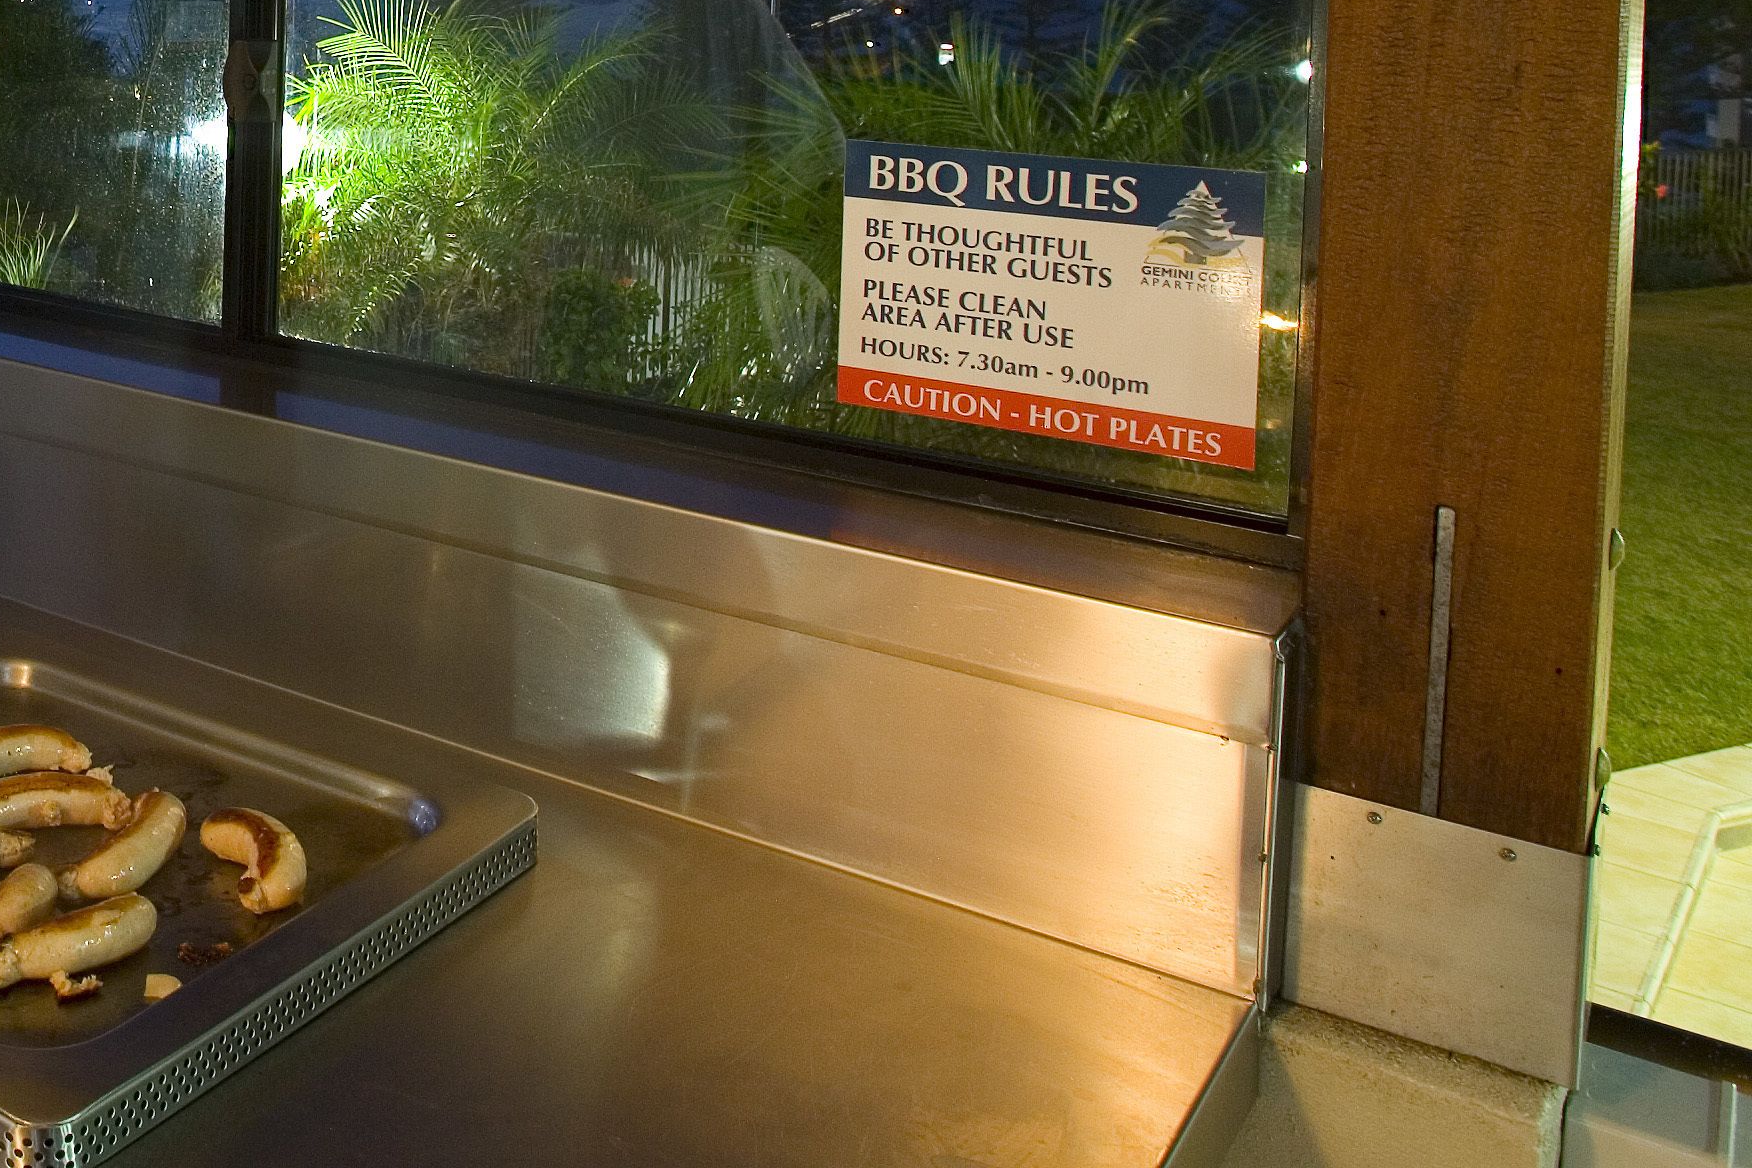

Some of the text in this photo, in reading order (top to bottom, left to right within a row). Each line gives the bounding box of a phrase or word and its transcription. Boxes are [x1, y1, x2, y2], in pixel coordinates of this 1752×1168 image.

[869, 154, 1140, 214] BBQ RULES
[865, 218, 1094, 262] BE THOUGHTFUL
[864, 241, 1112, 289] OF OTHER GUESTS
[1141, 265, 1253, 288] GEMINI COT
[863, 279, 1047, 321] PLEASE CLEAN
[861, 302, 1074, 349] AREA AFTER USE
[860, 336, 949, 366] HOURS:
[957, 351, 1038, 379] 7.30am
[1060, 365, 1149, 398] 9.00pm
[863, 379, 1001, 422] CAUTION
[1028, 405, 1099, 438] HOT
[1109, 417, 1223, 457] PLATES
